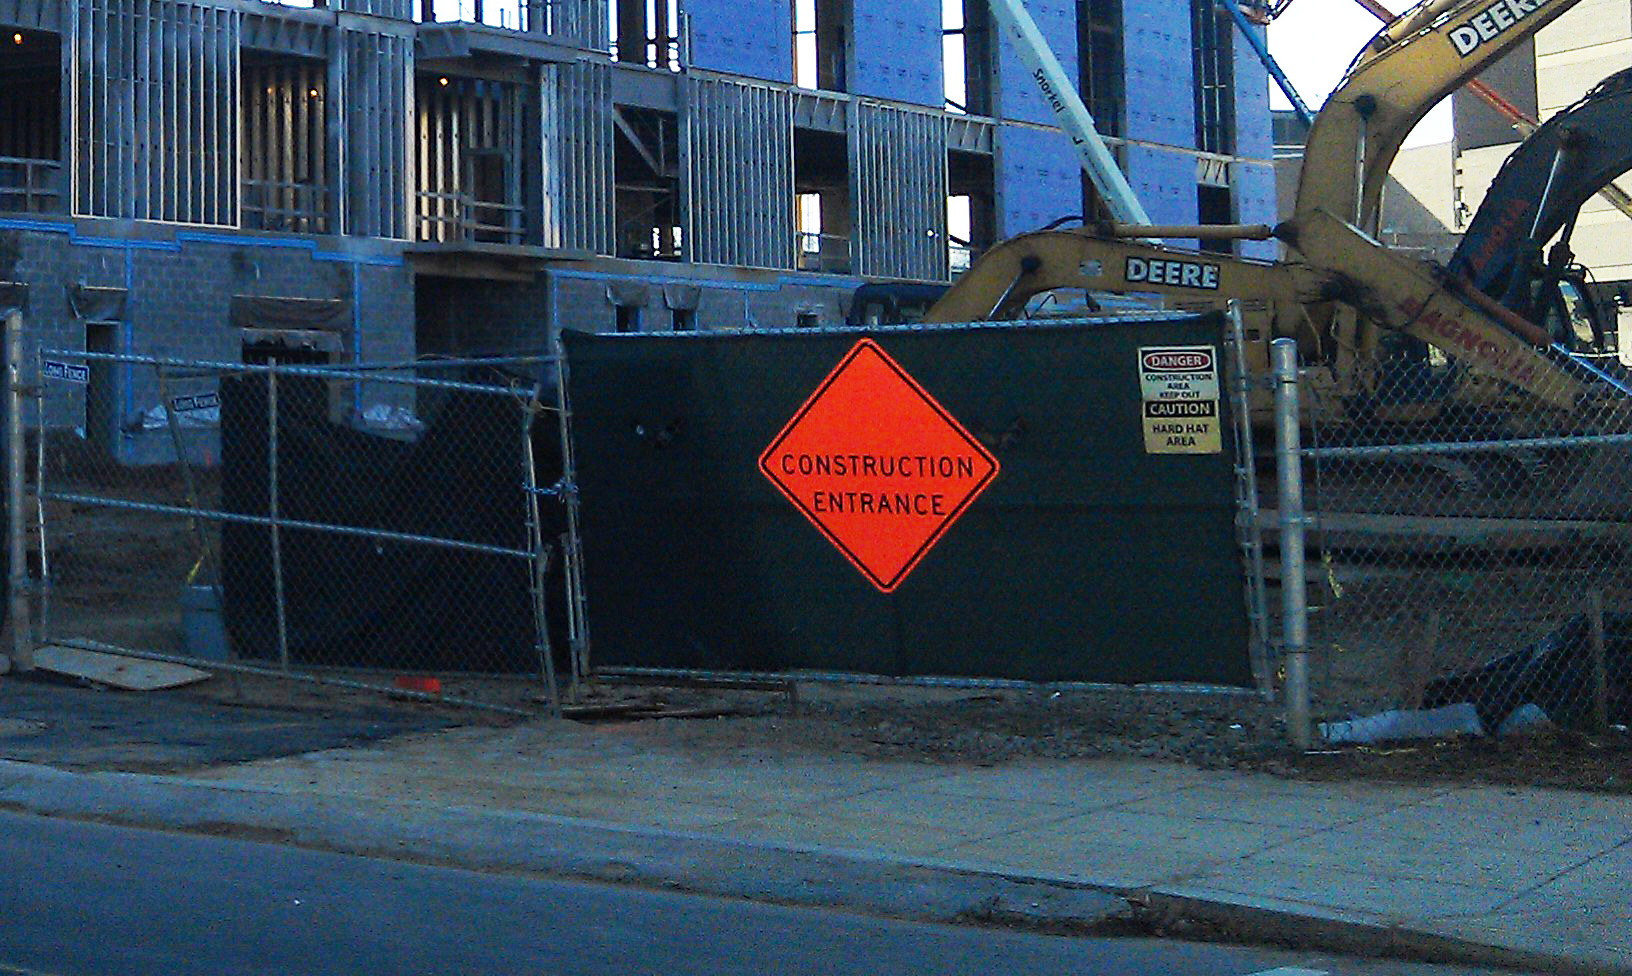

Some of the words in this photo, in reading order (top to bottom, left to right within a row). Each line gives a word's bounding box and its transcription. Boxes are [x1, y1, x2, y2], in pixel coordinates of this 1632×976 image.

[1033, 68, 1066, 113] Snorkel
[1126, 258, 1218, 288] DEERE
[1151, 355, 1202, 366] DANGER
[1145, 374, 1213, 382] CONSTRUCTION
[1167, 382, 1190, 390] AREA
[1181, 391, 1200, 399] OUT
[1150, 403, 1210, 415] CAUTION
[1152, 424, 1184, 434] HARD
[1186, 424, 1209, 434] HAT
[1166, 436, 1196, 446] AREA
[780, 454, 974, 478] CONSTRUCTION
[813, 491, 946, 516] ENTRANCE
